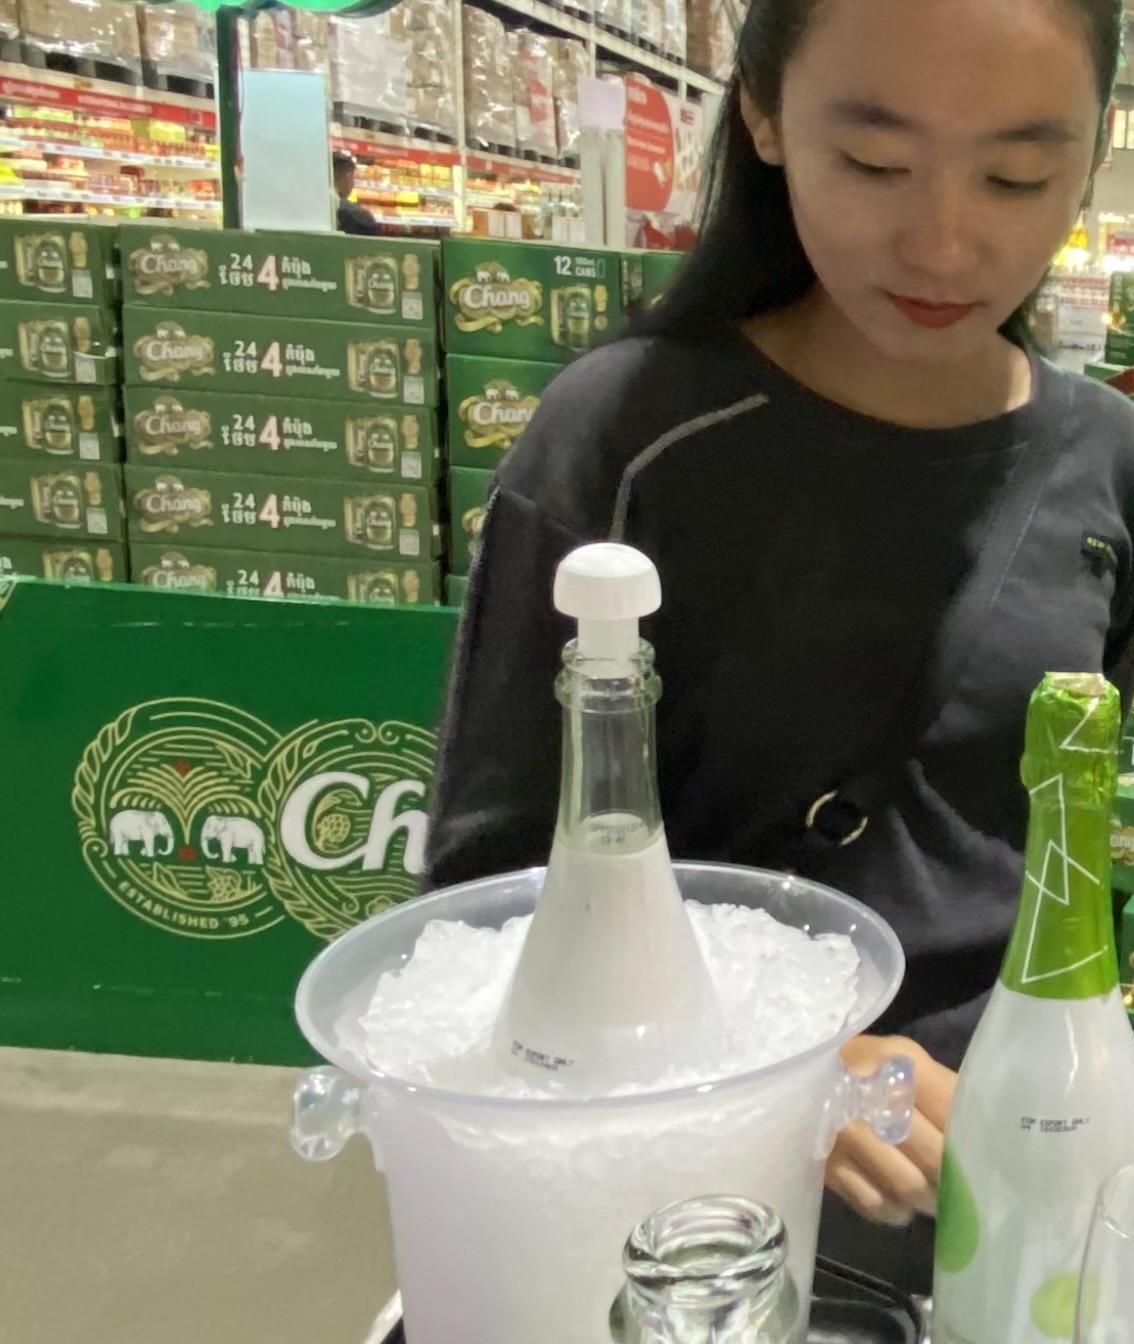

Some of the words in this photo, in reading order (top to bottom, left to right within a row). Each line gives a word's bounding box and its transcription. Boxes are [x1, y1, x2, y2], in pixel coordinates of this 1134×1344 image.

[139, 254, 198, 274] Chang
[230, 254, 254, 269] 24
[553, 255, 572, 275] 12
[257, 255, 280, 291] 4
[575, 267, 596, 278] CANS
[464, 284, 531, 308] Chang
[144, 342, 205, 361] Chang
[234, 341, 258, 357] 24
[261, 342, 283, 377] 4
[232, 415, 255, 431] 24
[473, 401, 535, 425] Chan
[144, 416, 200, 435] Chang
[259, 415, 281, 451] 4
[145, 495, 202, 514] Chang
[232, 493, 256, 508] 24
[259, 494, 281, 529] 4
[236, 570, 260, 586] 24
[263, 571, 285, 597] 4
[119, 881, 219, 931] ESTABLISHED
